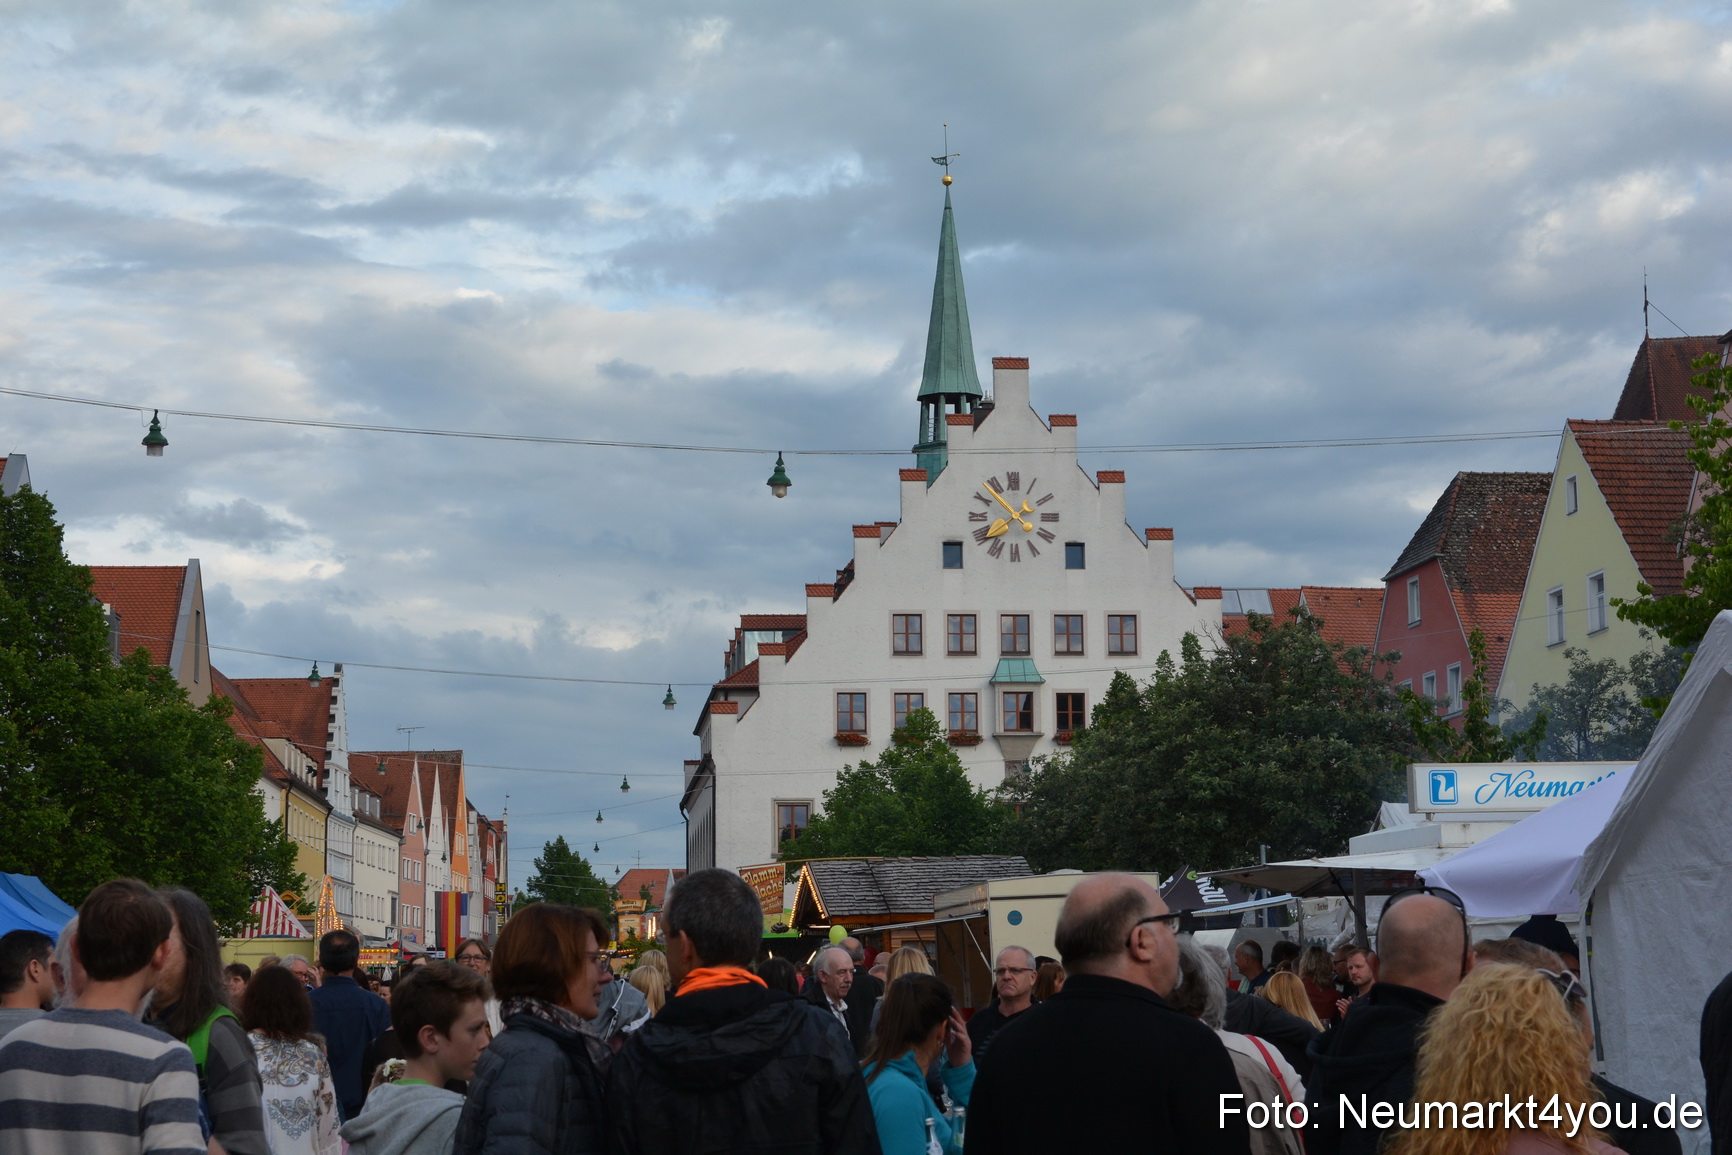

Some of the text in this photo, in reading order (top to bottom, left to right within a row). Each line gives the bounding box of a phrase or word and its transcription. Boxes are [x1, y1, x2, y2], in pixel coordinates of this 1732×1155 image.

[973, 491, 993, 507] X
[1035, 492, 1055, 507] II
[968, 511, 988, 522] IX
[1040, 512, 1060, 523] III
[1026, 539, 1041, 558] V
[1474, 769, 1616, 805] Neuma
